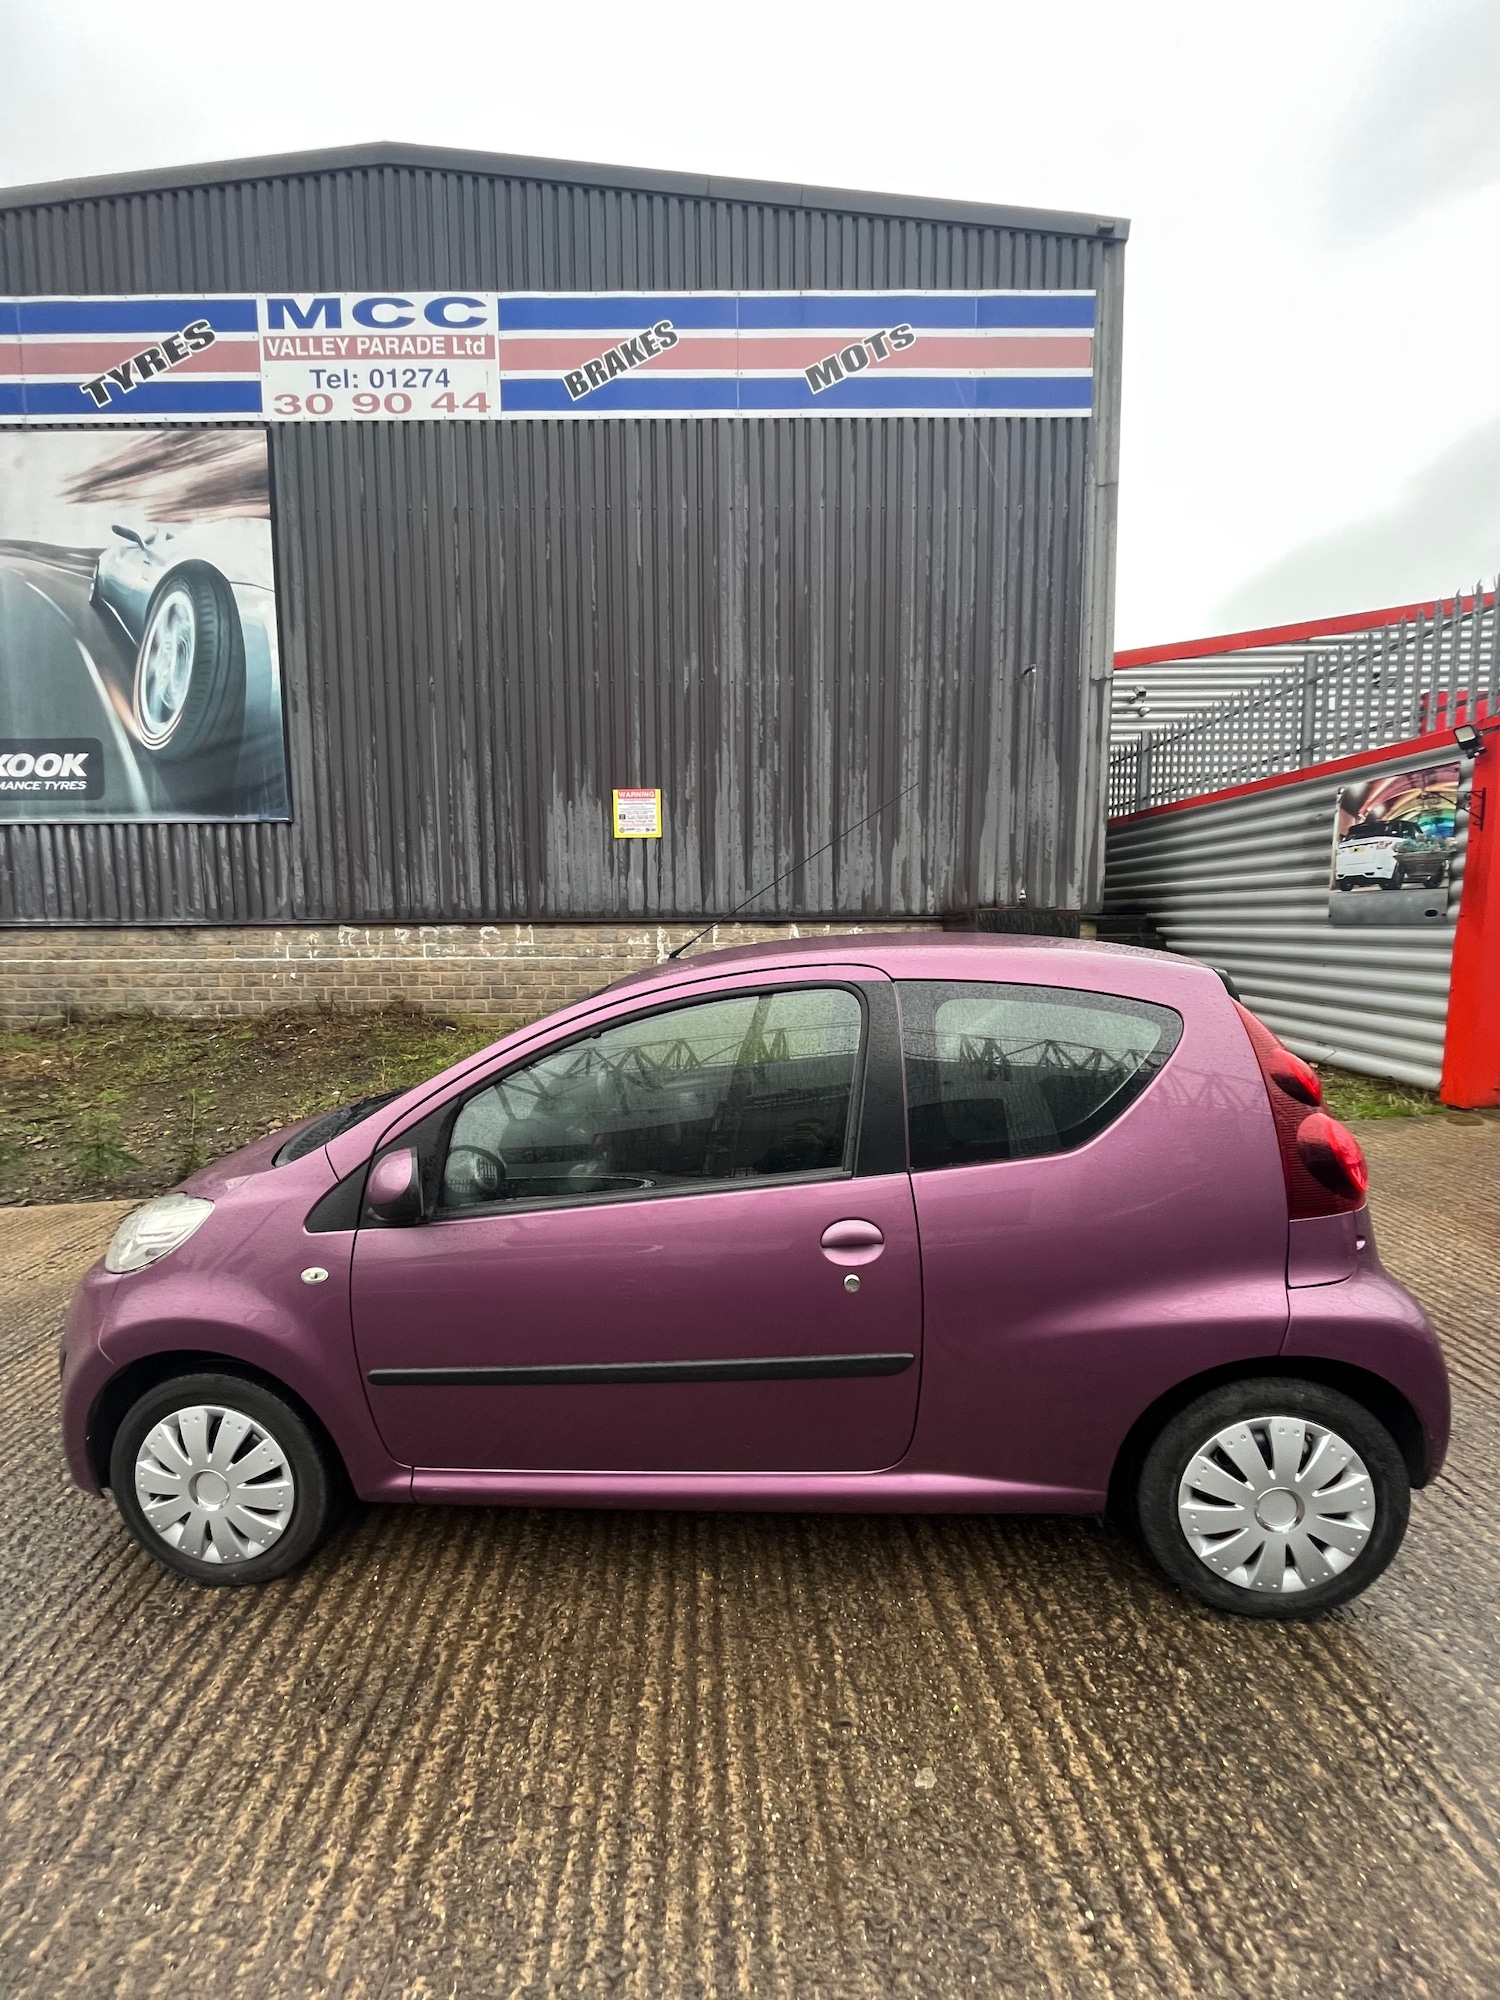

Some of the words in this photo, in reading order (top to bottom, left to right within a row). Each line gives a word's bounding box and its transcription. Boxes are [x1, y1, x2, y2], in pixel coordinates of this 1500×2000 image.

[267, 297, 488, 329] MCC
[266, 337, 350, 356] VALLEY
[357, 336, 446, 355] PARADE
[452, 336, 486, 355] Ltd
[804, 323, 916, 395] MOTS
[79, 319, 216, 408] TYRES
[562, 320, 679, 401] BRAKES
[309, 368, 358, 389] Tel:
[369, 368, 450, 388] 01274
[273, 393, 334, 415] 30
[352, 393, 412, 414] 90
[430, 392, 491, 413] 44
[44, 781, 87, 791] TYRES
